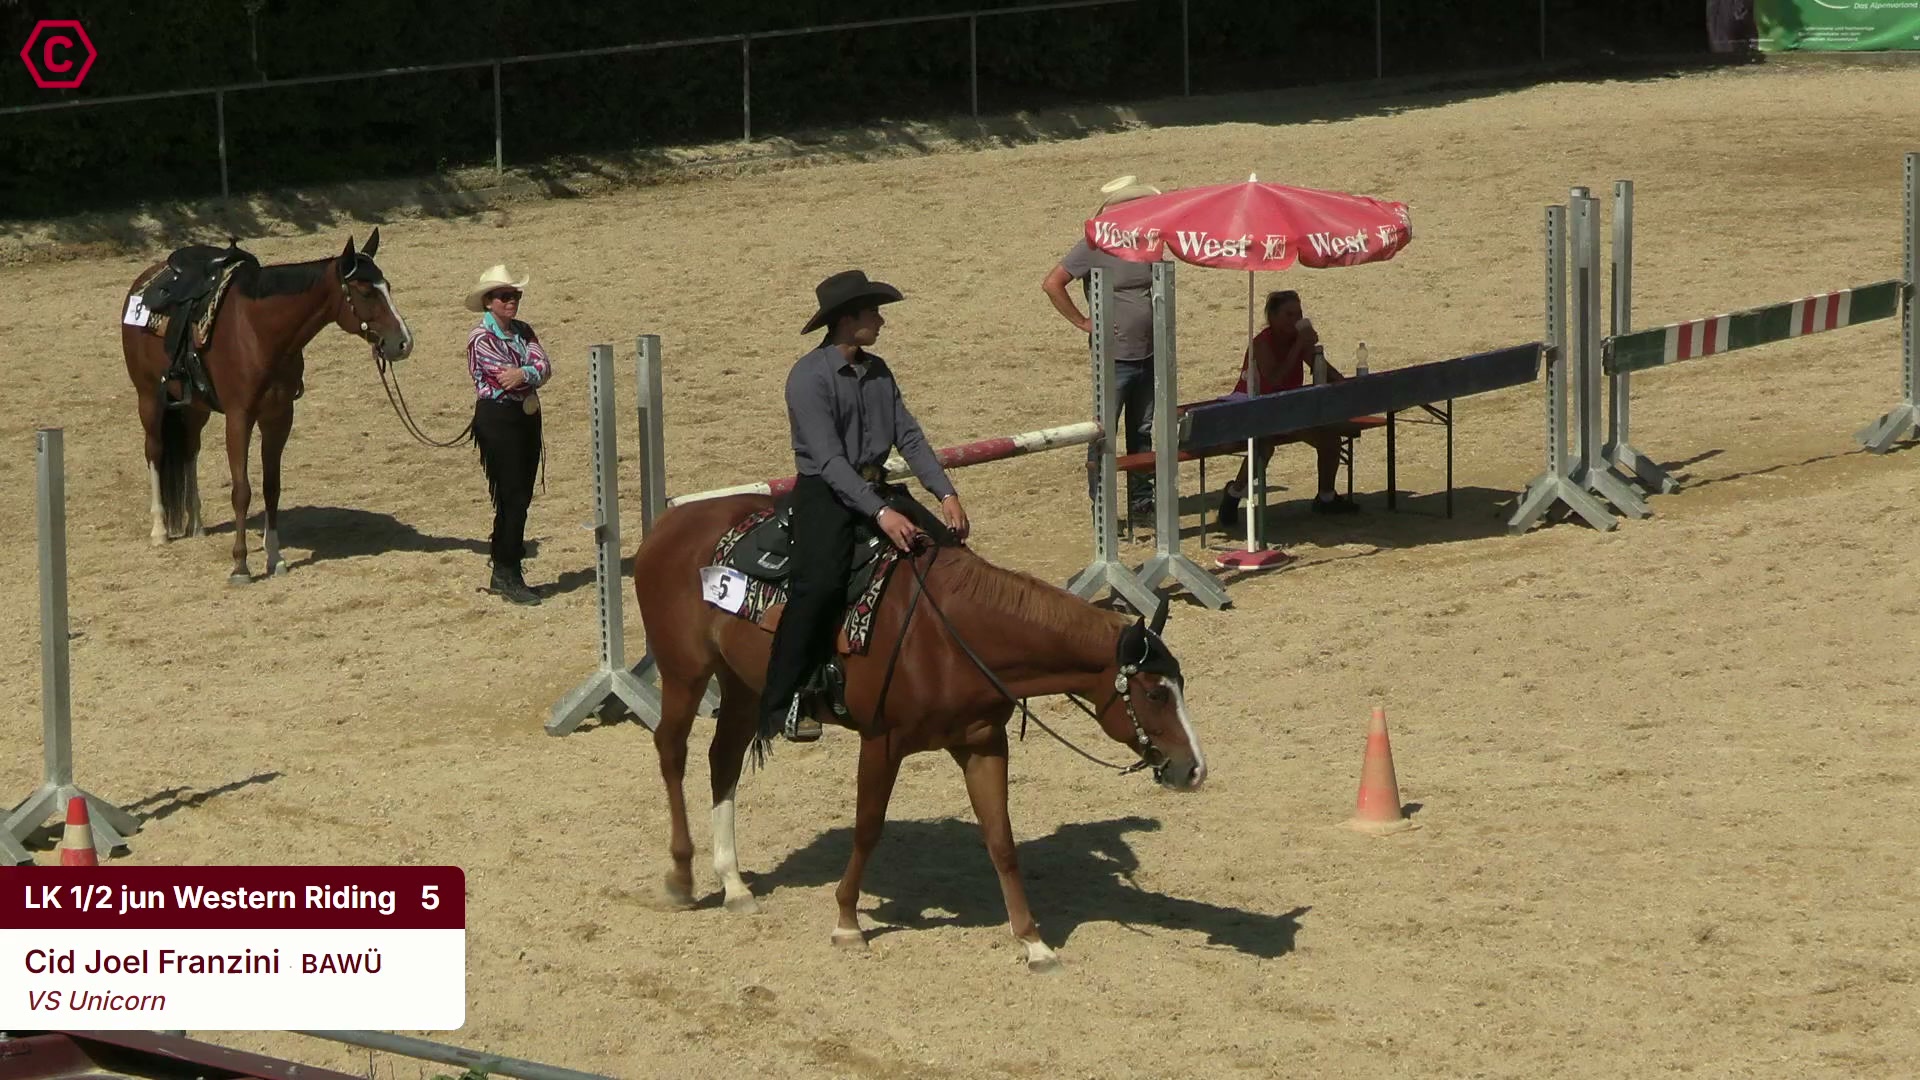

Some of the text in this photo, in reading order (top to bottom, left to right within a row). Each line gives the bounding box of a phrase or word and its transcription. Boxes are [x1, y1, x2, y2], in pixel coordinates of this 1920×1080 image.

[1094, 221, 1140, 250] West
[1176, 231, 1248, 257] West
[1307, 229, 1368, 256] West
[135, 302, 143, 321] 8
[719, 574, 731, 600] 5
